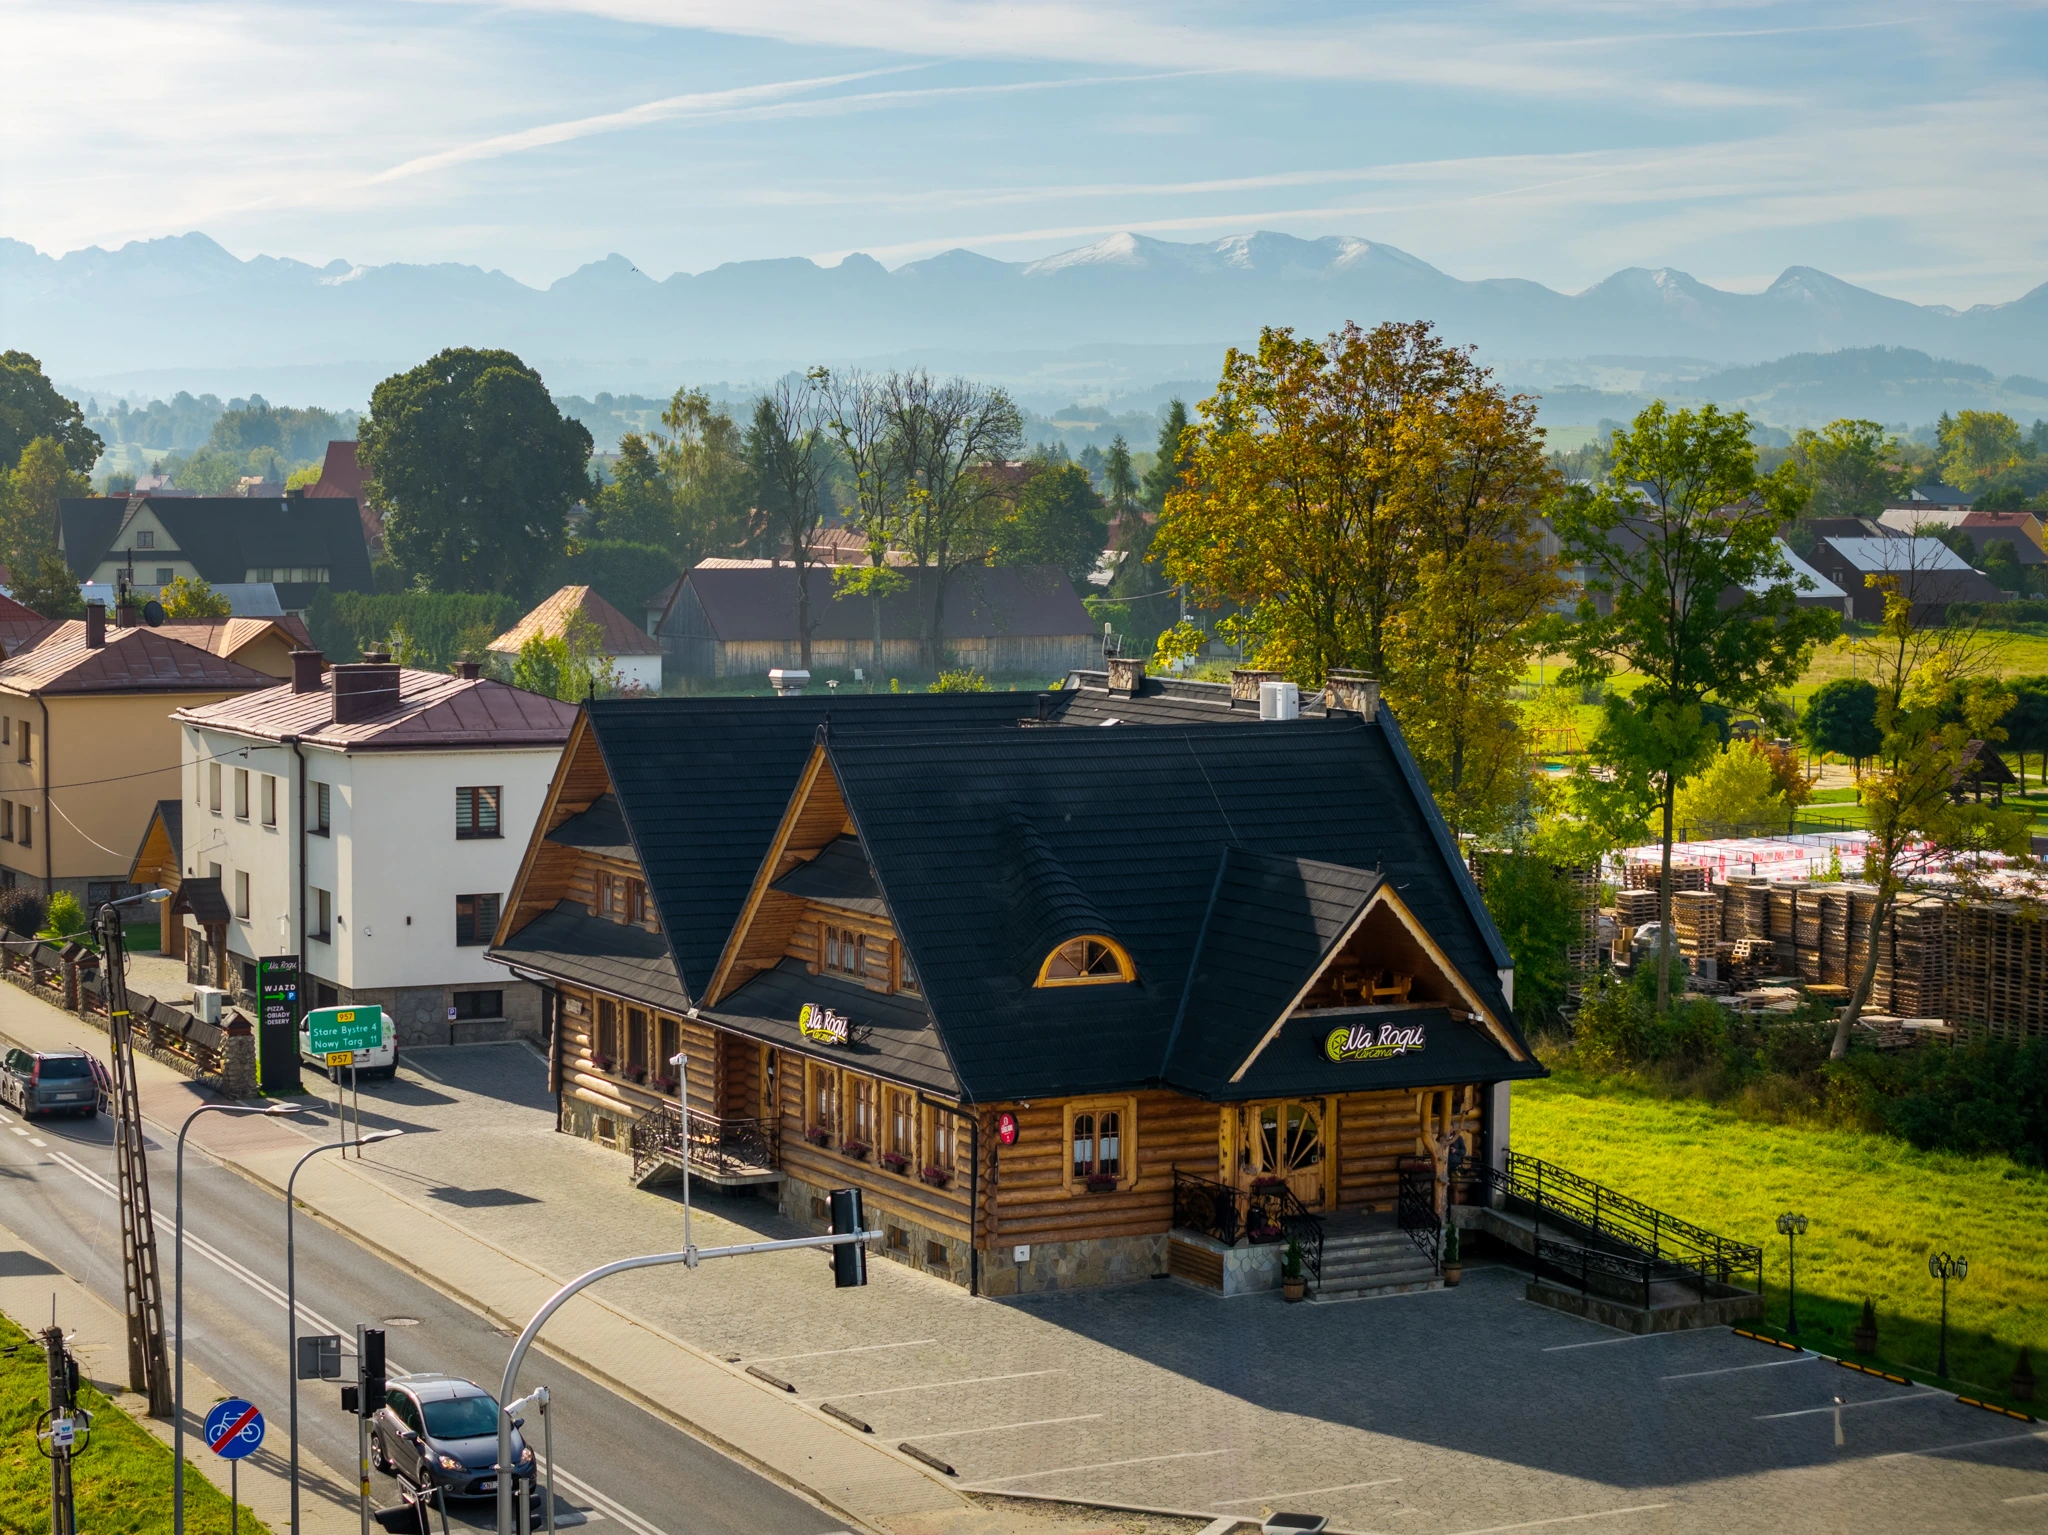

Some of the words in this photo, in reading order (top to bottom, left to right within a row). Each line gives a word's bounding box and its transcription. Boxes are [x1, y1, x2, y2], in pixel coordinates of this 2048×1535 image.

[313, 1028, 338, 1037] Stare
[341, 1025, 368, 1036] Bystre
[371, 1023, 377, 1031] 4
[806, 1006, 822, 1029] Na
[824, 1011, 847, 1041] Rogu
[314, 1040, 339, 1049] Nowy
[343, 1037, 363, 1047] Targ
[370, 1035, 377, 1044] 11
[1341, 1026, 1373, 1051] Na
[1378, 1024, 1424, 1053] Rogu
[331, 1054, 348, 1064] 957
[1355, 1048, 1392, 1059] Karczma
